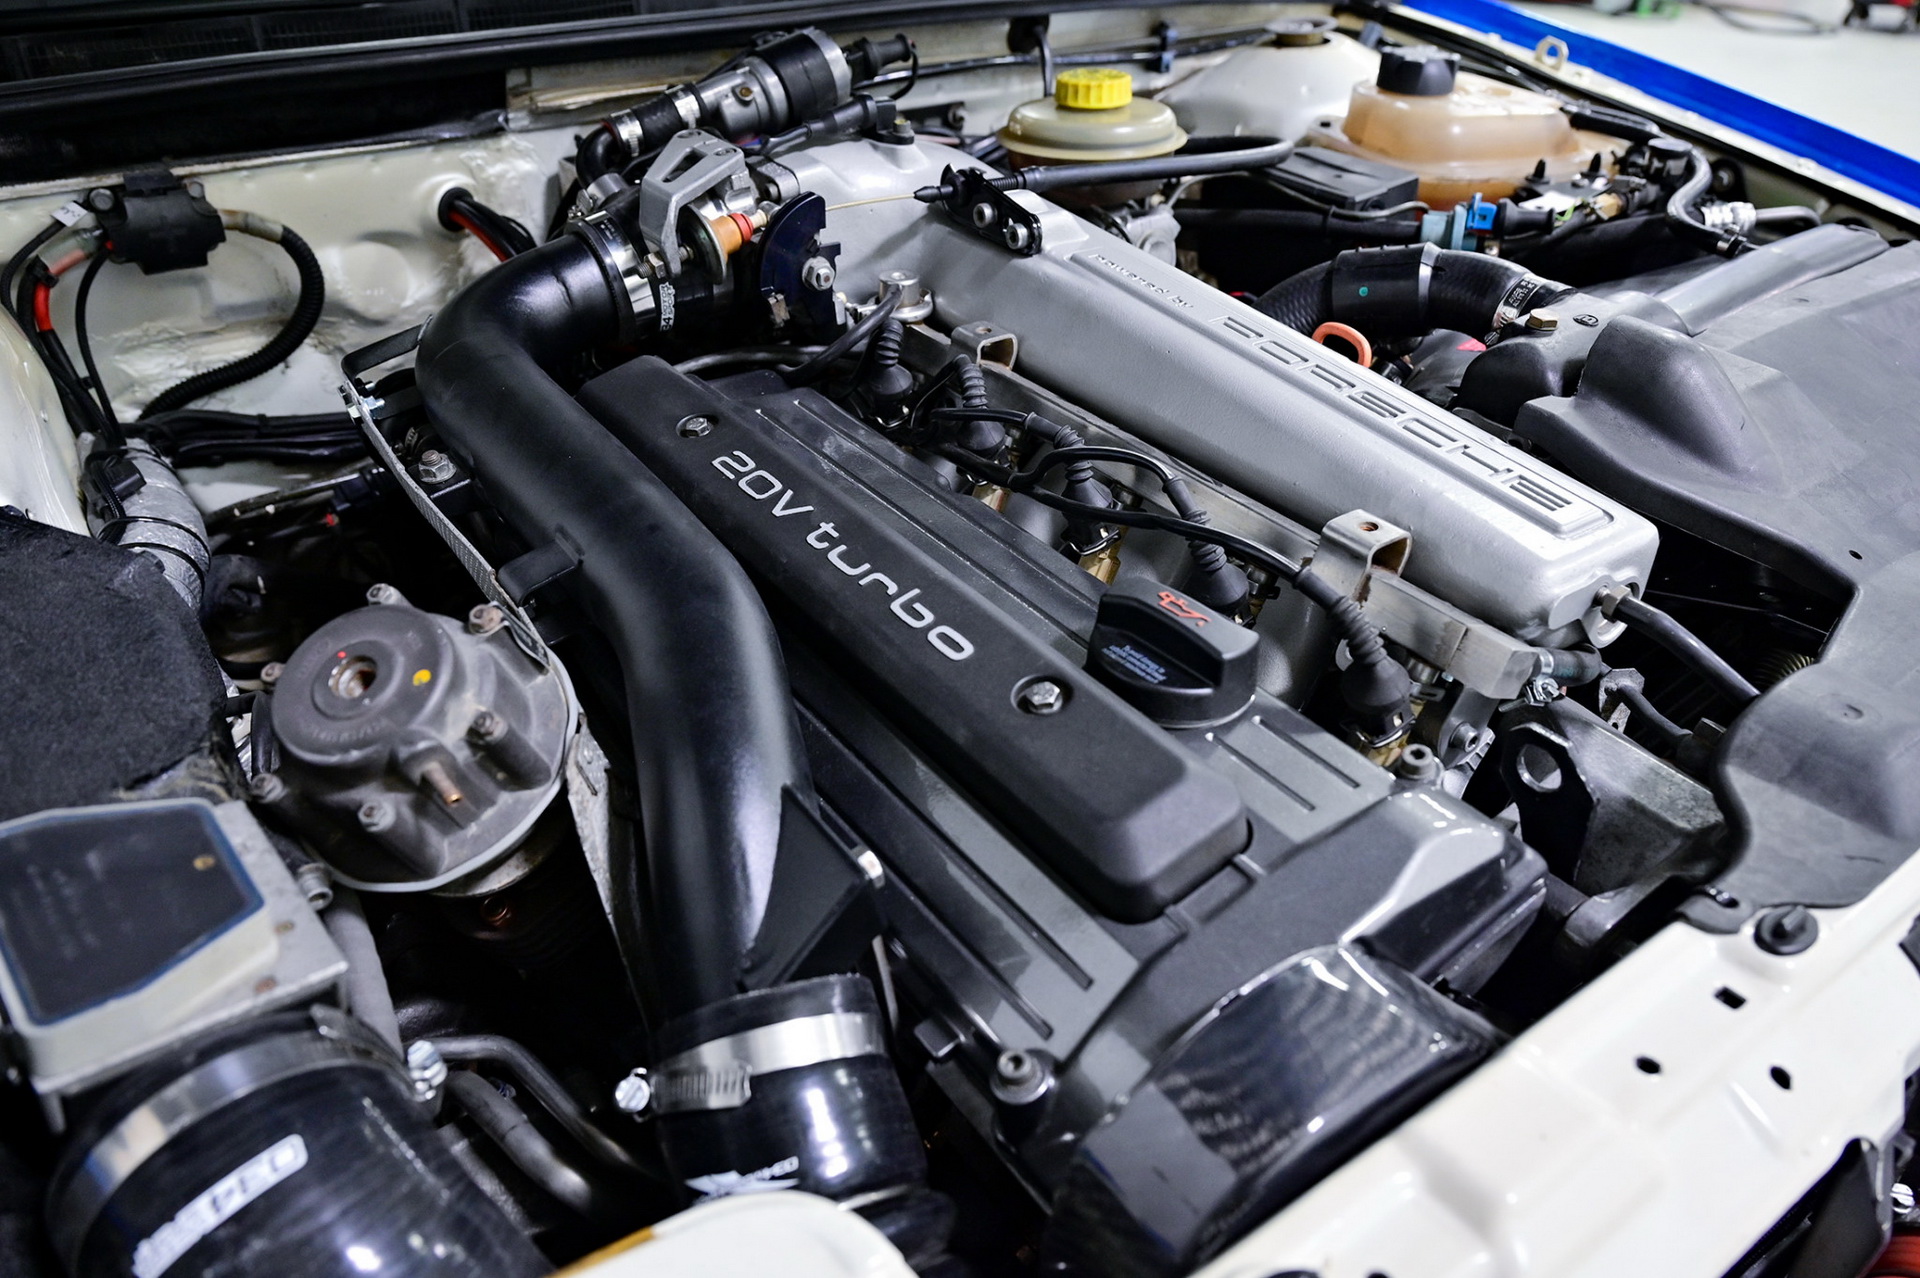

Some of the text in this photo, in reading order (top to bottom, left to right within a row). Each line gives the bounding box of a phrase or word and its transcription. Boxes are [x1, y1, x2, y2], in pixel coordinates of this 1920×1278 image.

[1208, 315, 1574, 512] PORSCHE
[712, 450, 974, 661] 20V turbo
